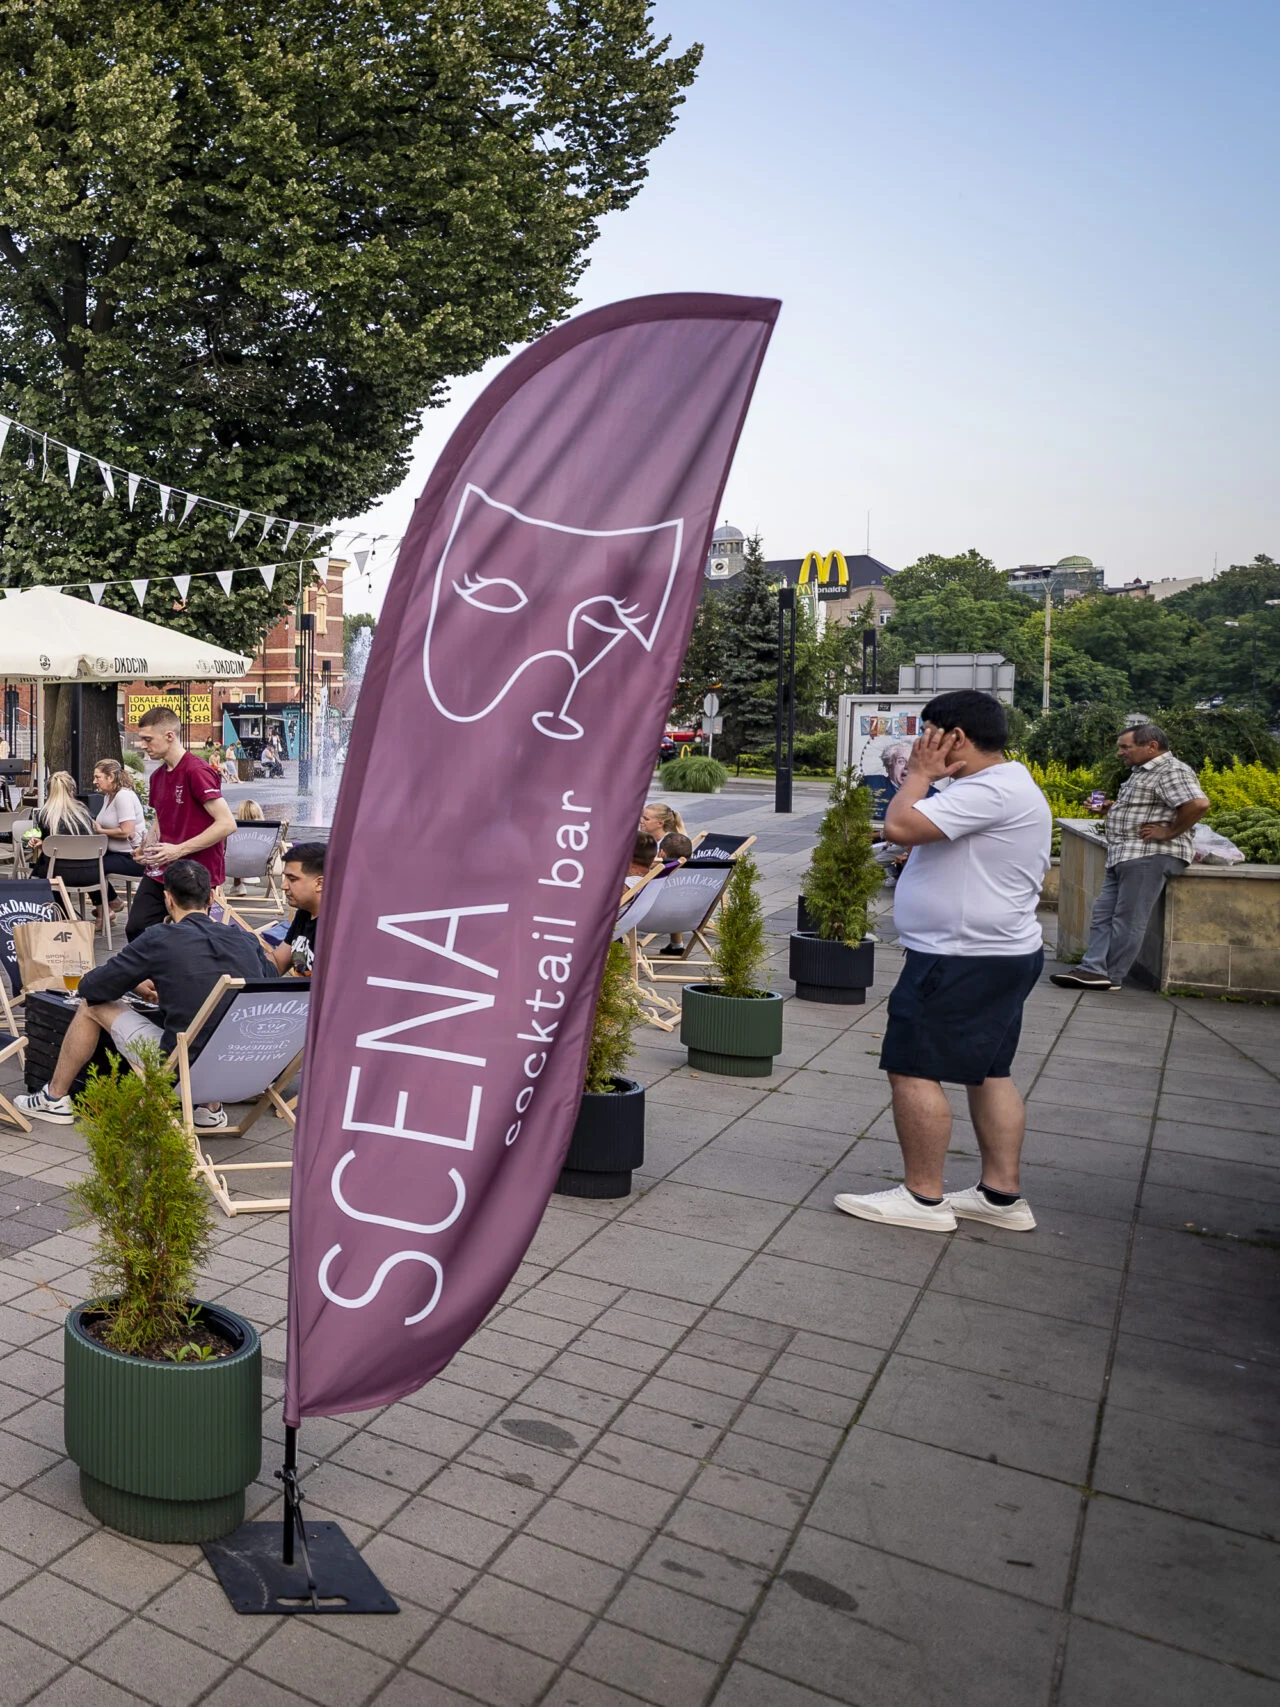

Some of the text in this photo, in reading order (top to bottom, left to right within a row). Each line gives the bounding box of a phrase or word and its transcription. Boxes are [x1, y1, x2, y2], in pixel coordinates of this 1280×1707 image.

[114, 657, 149, 674] OKOCIM
[213, 660, 246, 675] OKOCIM
[129, 695, 211, 704] LOKALE HANOWE
[130, 703, 146, 713] DO
[9, 899, 54, 920] DANIEL'S
[53, 931, 73, 943] 4F
[505, 790, 592, 1146] cocktail bar
[317, 902, 509, 1326] SCENA
